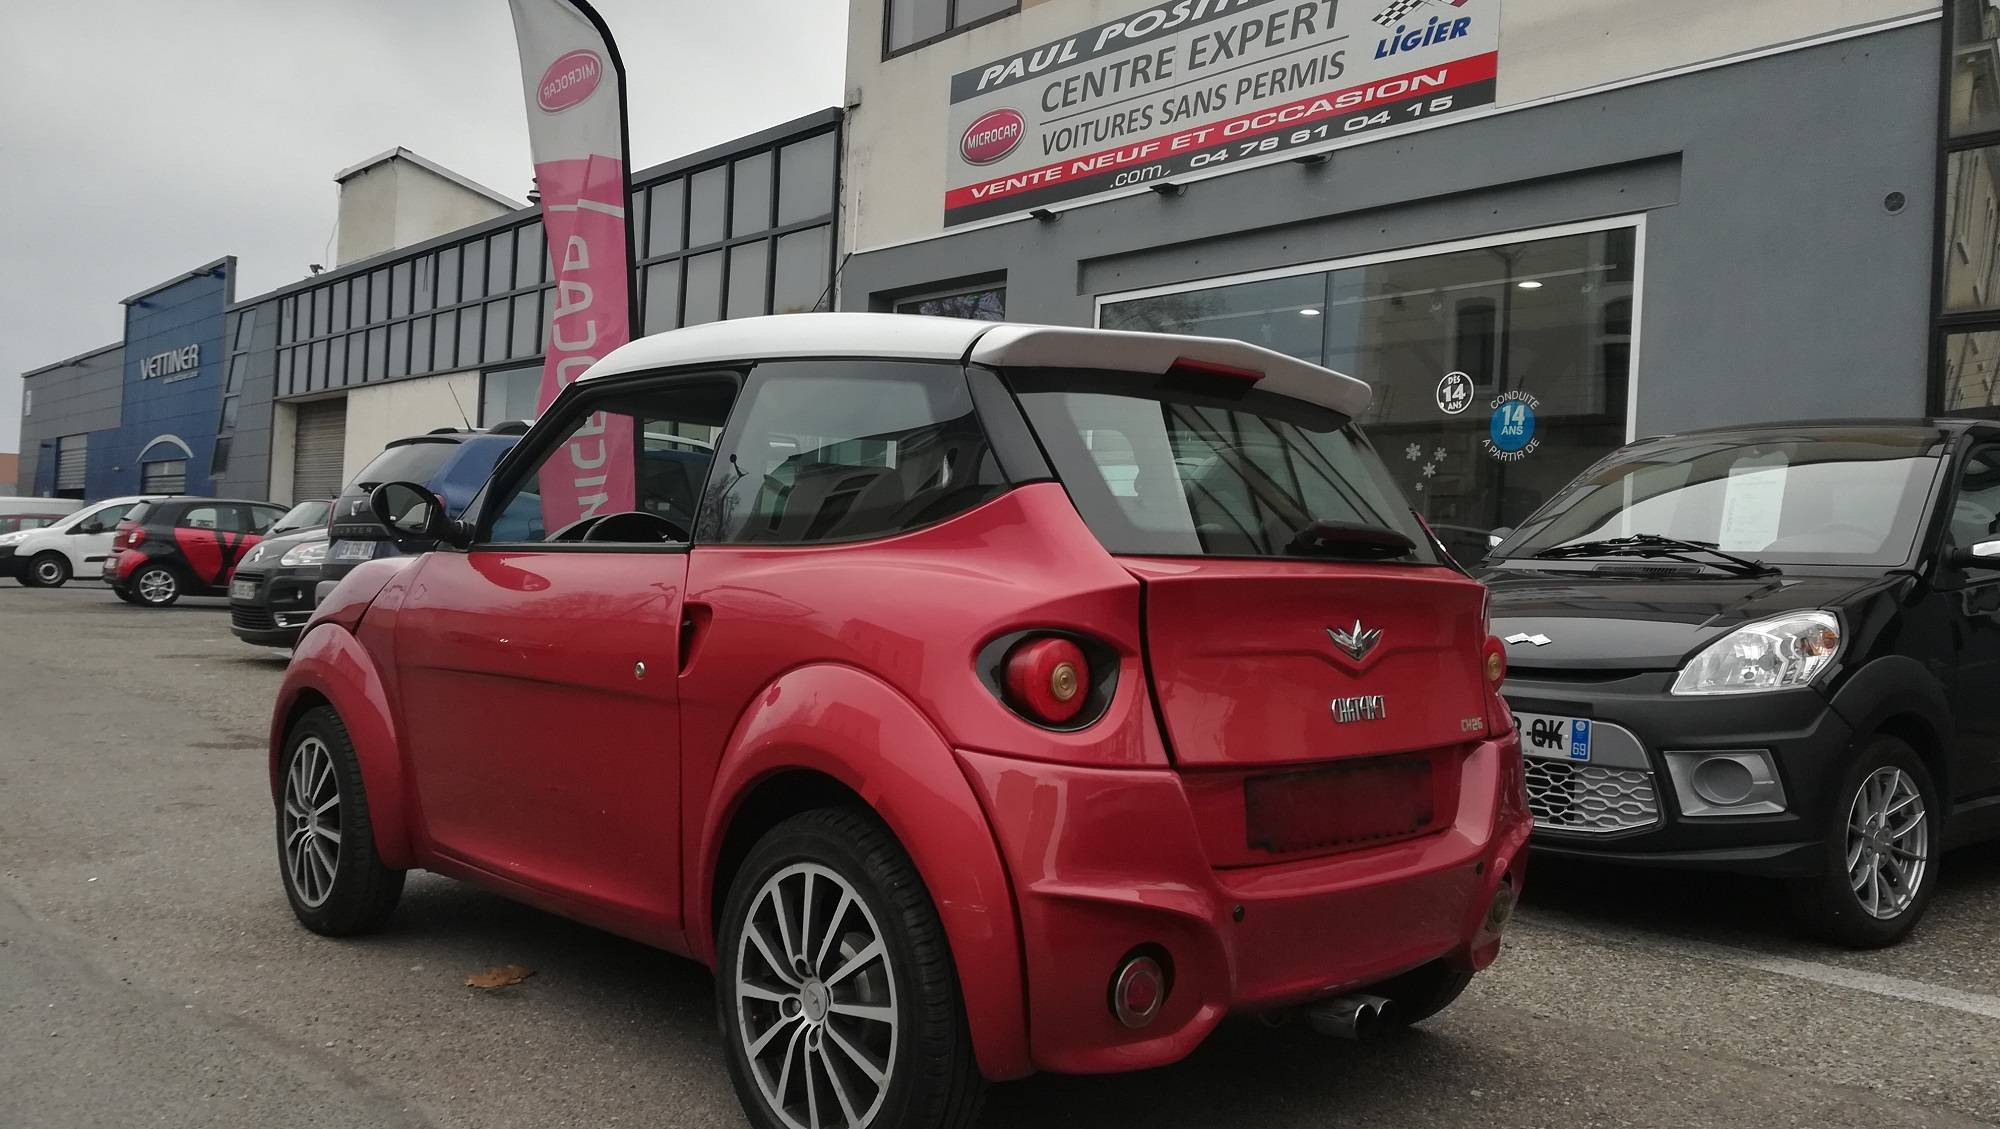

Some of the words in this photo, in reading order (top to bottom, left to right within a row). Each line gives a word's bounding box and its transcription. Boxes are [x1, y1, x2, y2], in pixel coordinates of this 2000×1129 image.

[976, 38, 1081, 91] PAUL
[1040, 46, 1177, 113] CENTRE
[1188, 0, 1339, 71] EXPERT
[1042, 105, 1154, 156] VOITURES
[1160, 83, 1228, 126] SANS
[1236, 50, 1346, 105] PERMIS
[967, 123, 1018, 150] MICROCAR
[971, 166, 1063, 199] VENTE
[1071, 142, 1160, 174] NEUF
[1171, 128, 1215, 150] ET
[1223, 70, 1448, 136] OCCASION
[1190, 149, 1229, 167] 04
[1240, 137, 1280, 157] 78
[1290, 124, 1330, 144] 61
[1343, 110, 1392, 132] 04
[1406, 95, 1454, 117] 15
[140, 344, 199, 380] VETTINER
[1442, 384, 1467, 403] 14
[1490, 390, 1540, 410] CONDUITE
[1447, 401, 1463, 411] ANS
[1502, 404, 1526, 426] 14
[1501, 425, 1524, 436] ANS
[1488, 446, 1526, 462] PARTIR
[1525, 438, 1540, 454] DE
[1460, 716, 1483, 732] CH26
[1572, 742, 1587, 756] 69
